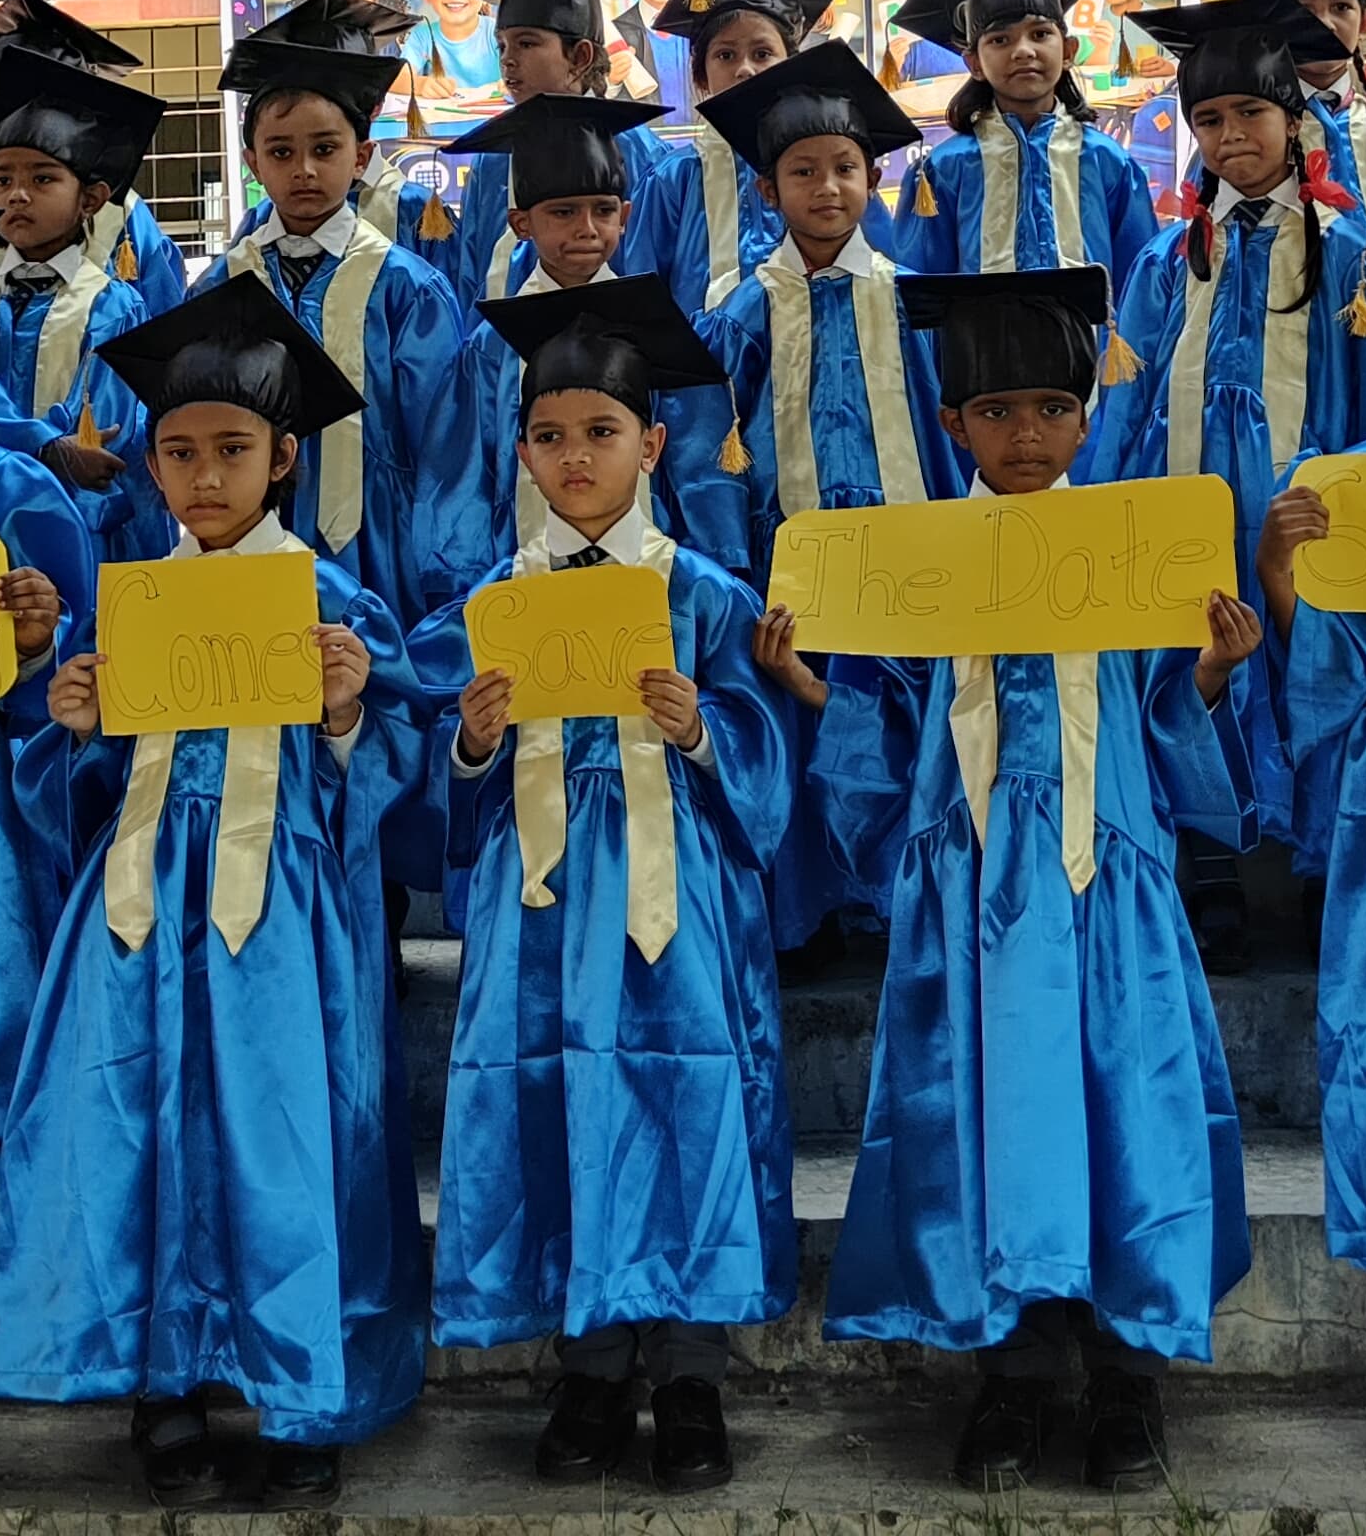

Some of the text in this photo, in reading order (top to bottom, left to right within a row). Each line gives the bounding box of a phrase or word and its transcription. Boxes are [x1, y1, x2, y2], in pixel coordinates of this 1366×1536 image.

[787, 499, 1218, 621] The Date
[104, 569, 324, 720] Comes
[473, 586, 672, 693] Save
